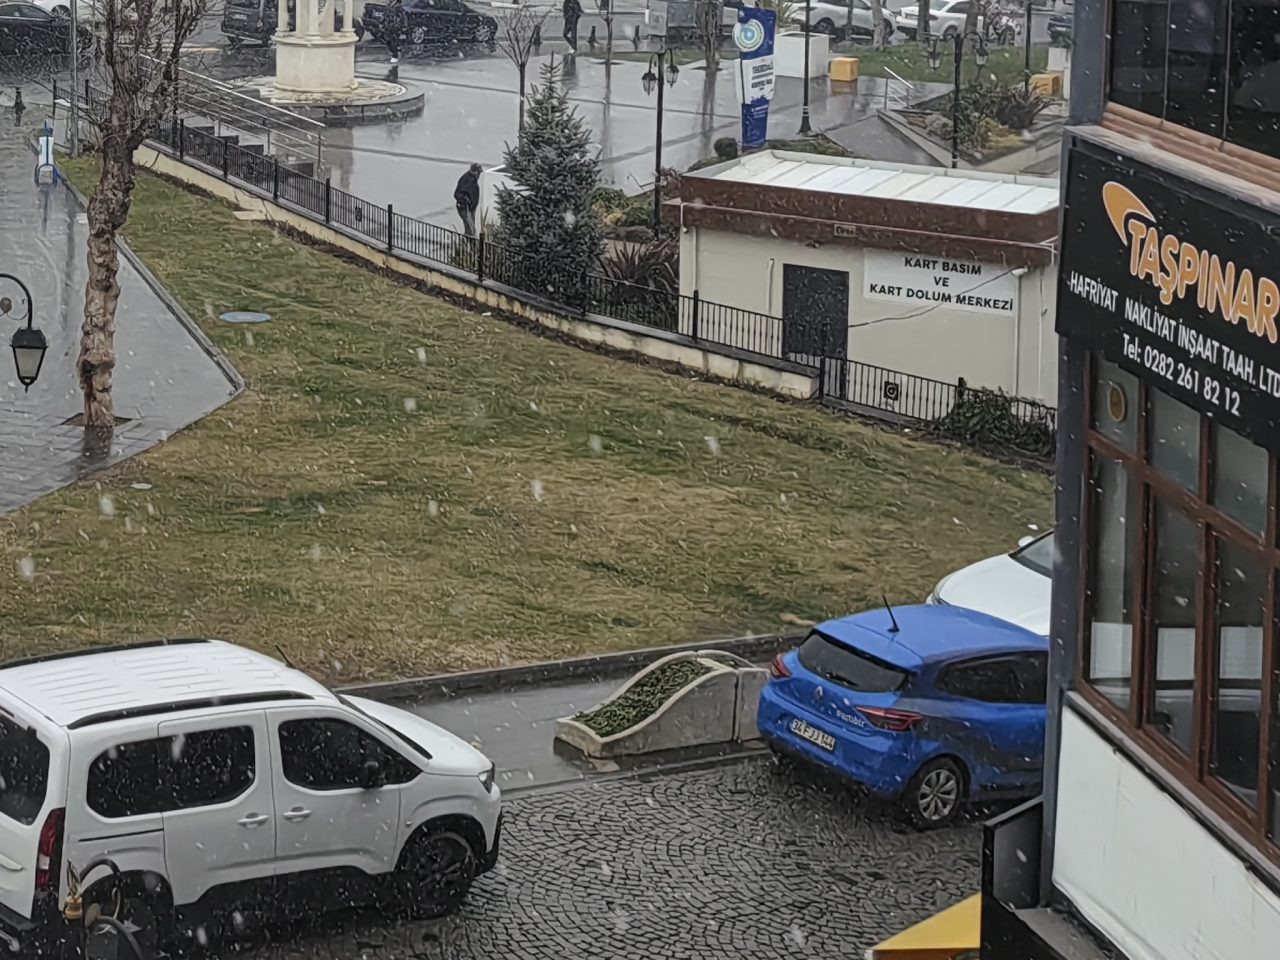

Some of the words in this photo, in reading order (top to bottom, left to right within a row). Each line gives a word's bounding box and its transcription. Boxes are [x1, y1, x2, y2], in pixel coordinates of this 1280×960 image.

[904, 256, 939, 270] KART
[941, 262, 982, 276] BASIM
[933, 276, 950, 287] VE
[1128, 218, 1279, 344] TAŞPINAR
[870, 283, 903, 297] KART
[906, 289, 952, 304] DOLUM
[955, 294, 1014, 311] MERKEZİ
[1070, 270, 1119, 312] HAFRİYAT
[1125, 297, 1176, 342] NAKLİYAT
[1178, 318, 1220, 364] İNŞAAT
[1221, 344, 1256, 386] TAAH.
[1123, 333, 1141, 363] Tel:
[1144, 345, 1174, 380] 0282
[1177, 363, 1199, 394] 261
[1203, 376, 1220, 405] 82
[1225, 387, 1241, 417] 12
